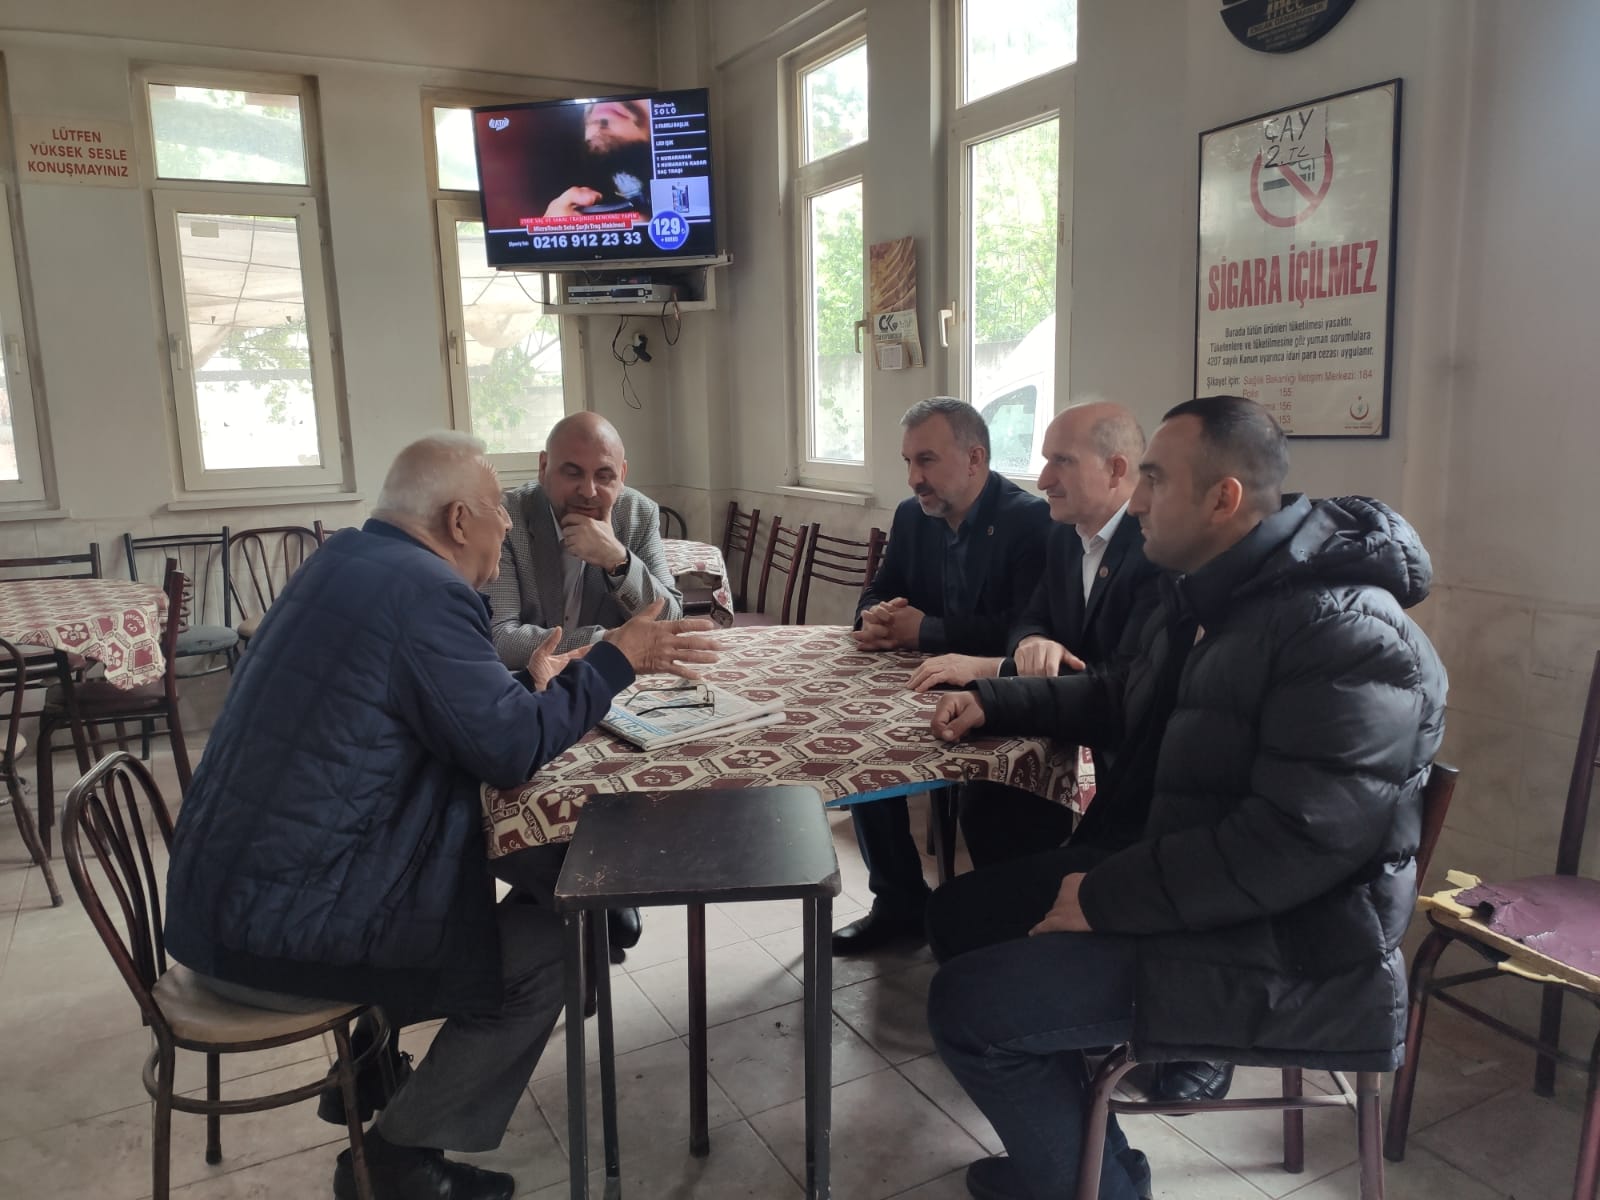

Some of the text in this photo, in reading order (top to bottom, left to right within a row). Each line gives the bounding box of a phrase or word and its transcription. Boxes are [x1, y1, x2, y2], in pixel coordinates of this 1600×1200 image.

[654, 107, 676, 116] SOLO
[52, 126, 102, 143] LÜTFEN
[30, 141, 127, 161] YÜKSEK SESLE
[28, 160, 129, 177] KONUŞMAYINIZ
[653, 217, 681, 236] 129
[533, 236, 568, 249] 0216
[571, 234, 598, 247] 912
[601, 233, 619, 246] 23
[624, 232, 641, 245] 33
[1208, 240, 1378, 311] SİGARA İÇİLMEZ
[1359, 369, 1373, 380] 184
